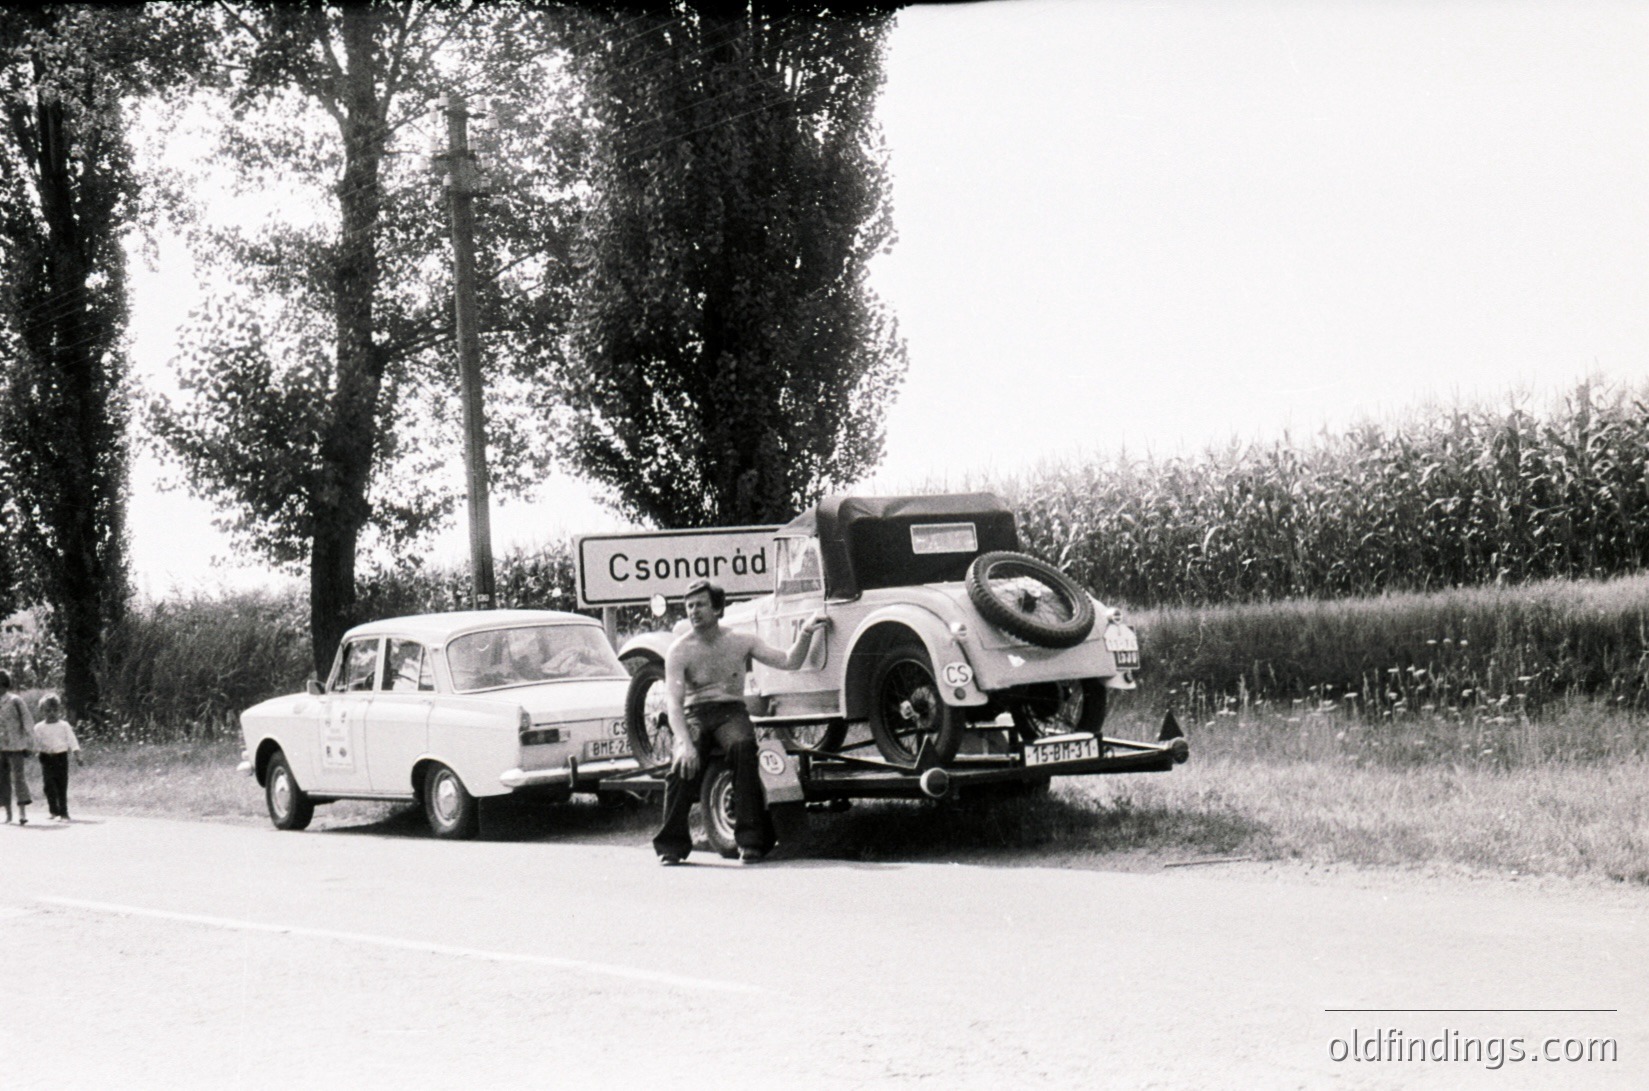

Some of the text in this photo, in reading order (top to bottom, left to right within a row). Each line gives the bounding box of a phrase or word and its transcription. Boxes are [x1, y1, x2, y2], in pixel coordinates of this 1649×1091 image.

[609, 547, 767, 582] Csonarád
[946, 664, 969, 684] CS
[613, 722, 627, 736] CS
